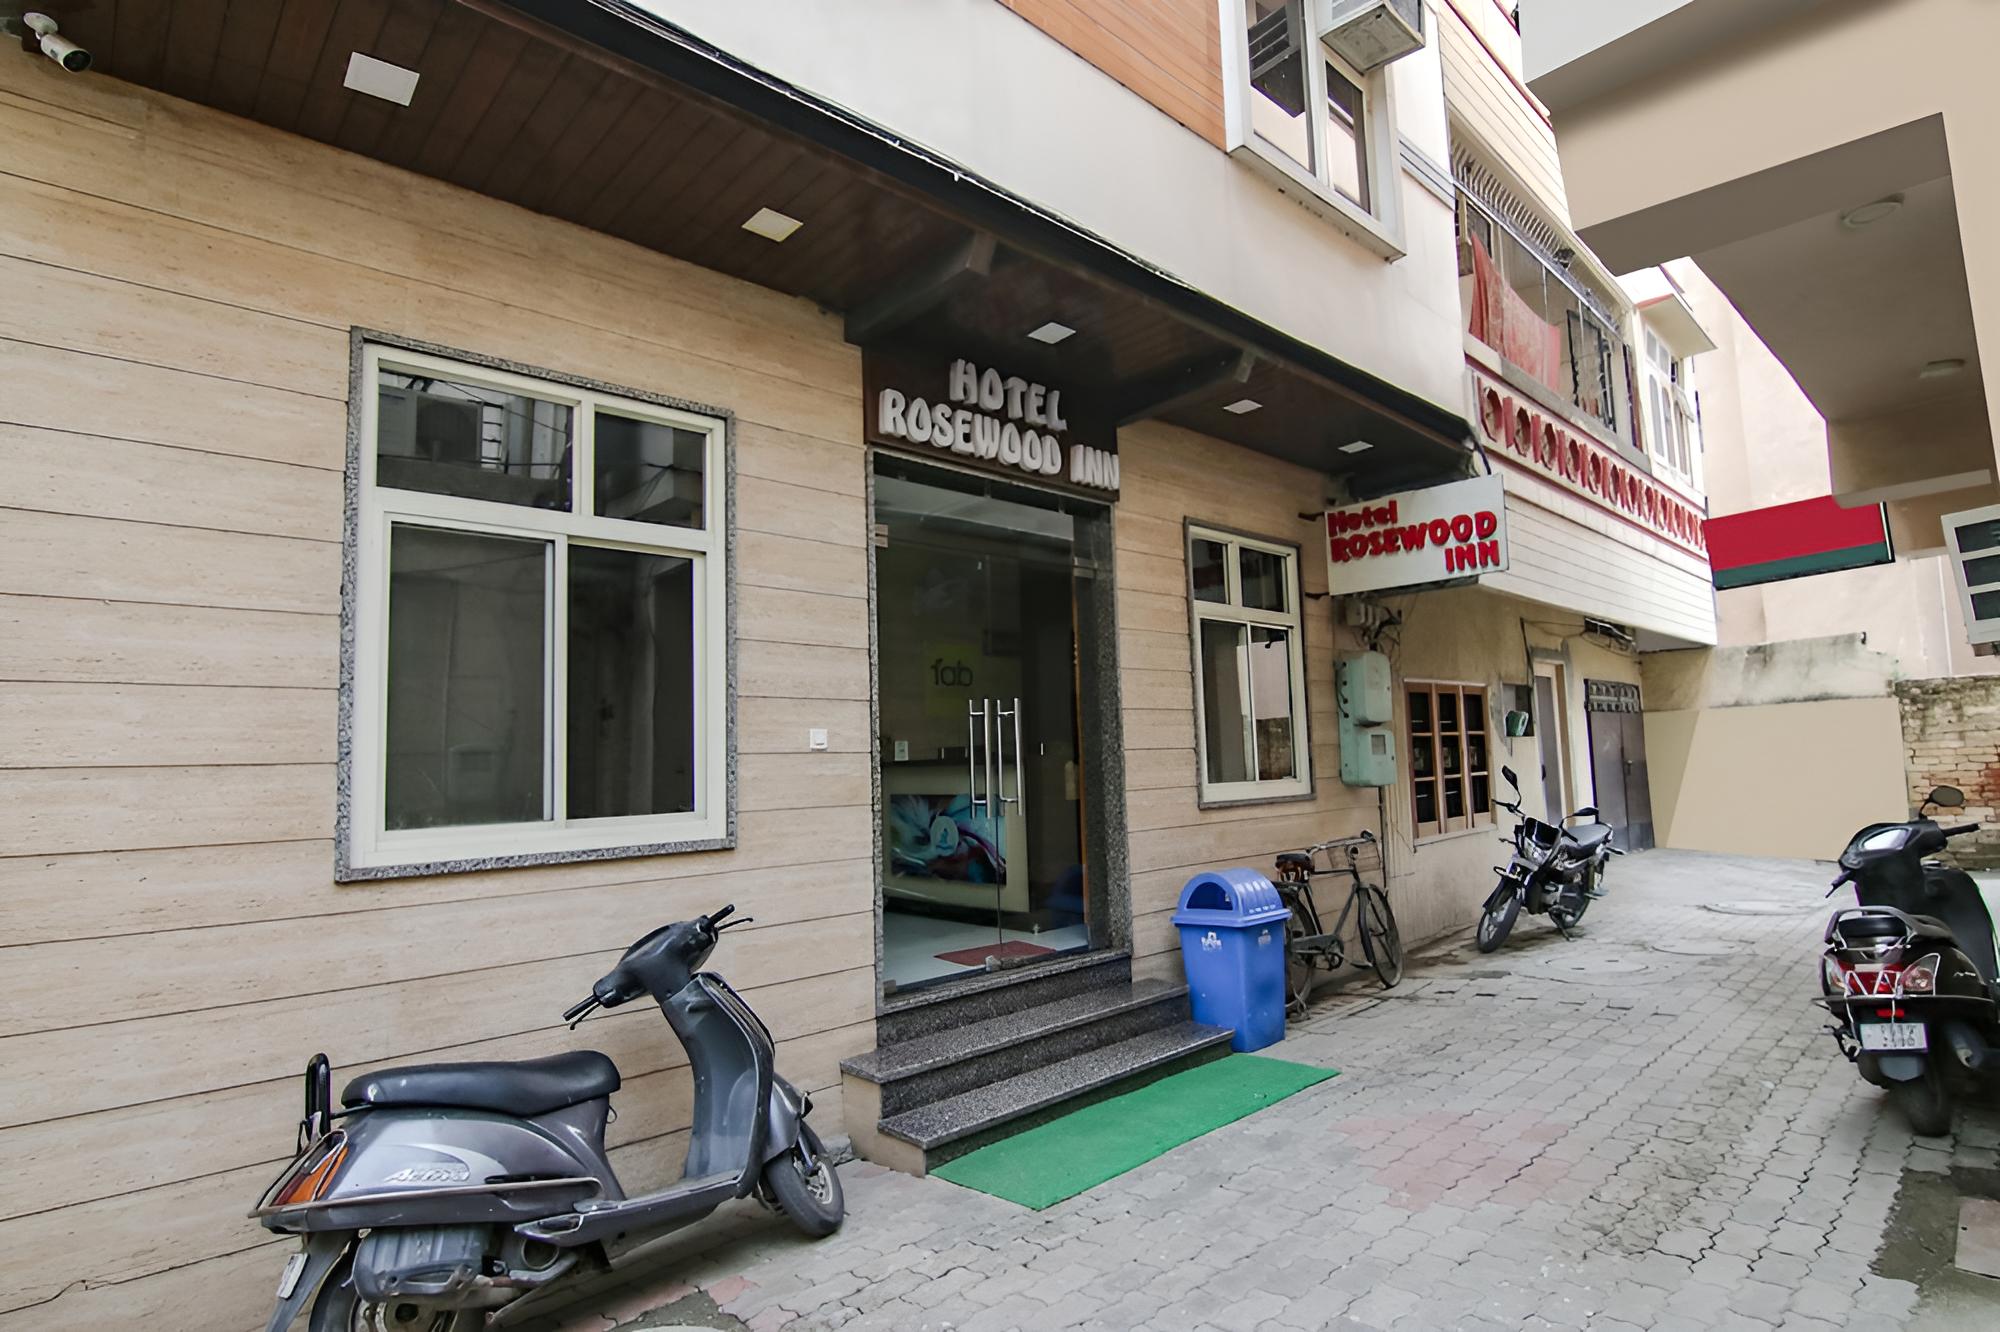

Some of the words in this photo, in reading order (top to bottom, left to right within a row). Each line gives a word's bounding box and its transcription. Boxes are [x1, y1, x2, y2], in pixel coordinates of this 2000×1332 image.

[950, 358, 1067, 431] HOTEL
[879, 388, 1062, 475] ROSEWOOD
[1070, 444, 1119, 490] INN
[1327, 500, 1398, 537] Hotel
[1330, 511, 1497, 563] ROSEWOOD
[1444, 540, 1500, 572] INN
[931, 658, 973, 687] fab
